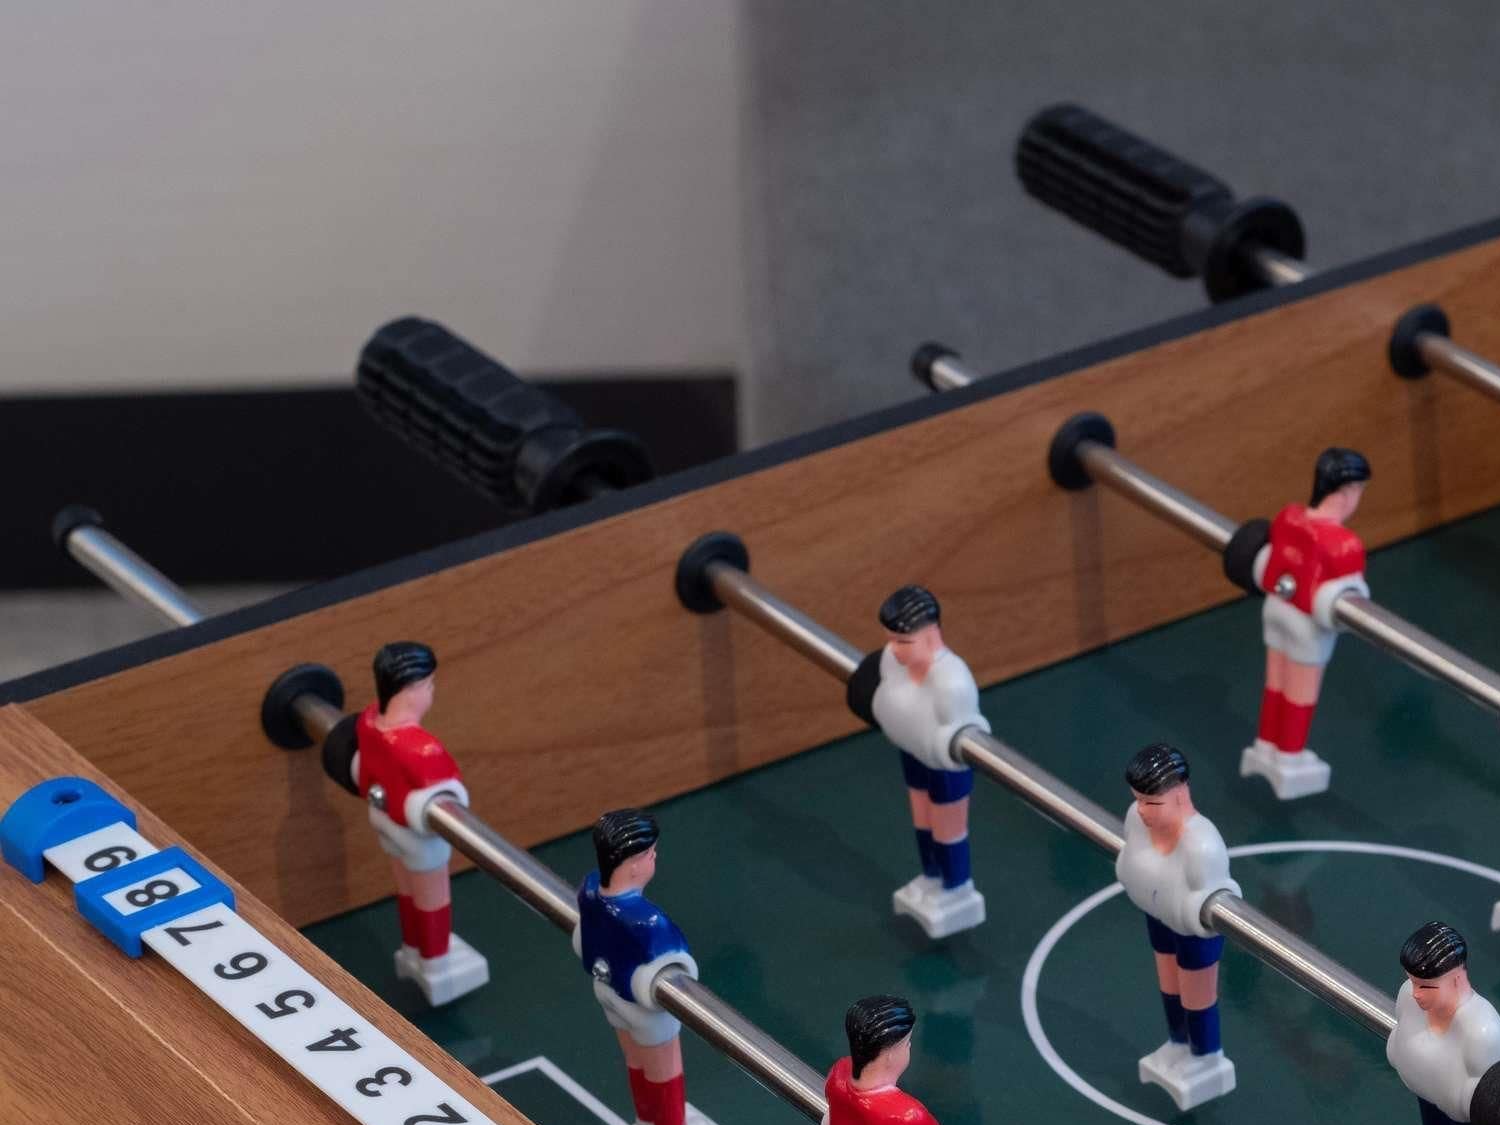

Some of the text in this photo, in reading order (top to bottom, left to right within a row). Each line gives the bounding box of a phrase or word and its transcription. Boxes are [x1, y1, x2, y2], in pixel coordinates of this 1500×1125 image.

[84, 845, 137, 873] 9
[125, 879, 179, 907] 8
[163, 919, 224, 946] 7
[213, 951, 268, 982] 6
[255, 989, 316, 1020] 5
[304, 1027, 363, 1055] 4
[355, 1066, 412, 1098] 3
